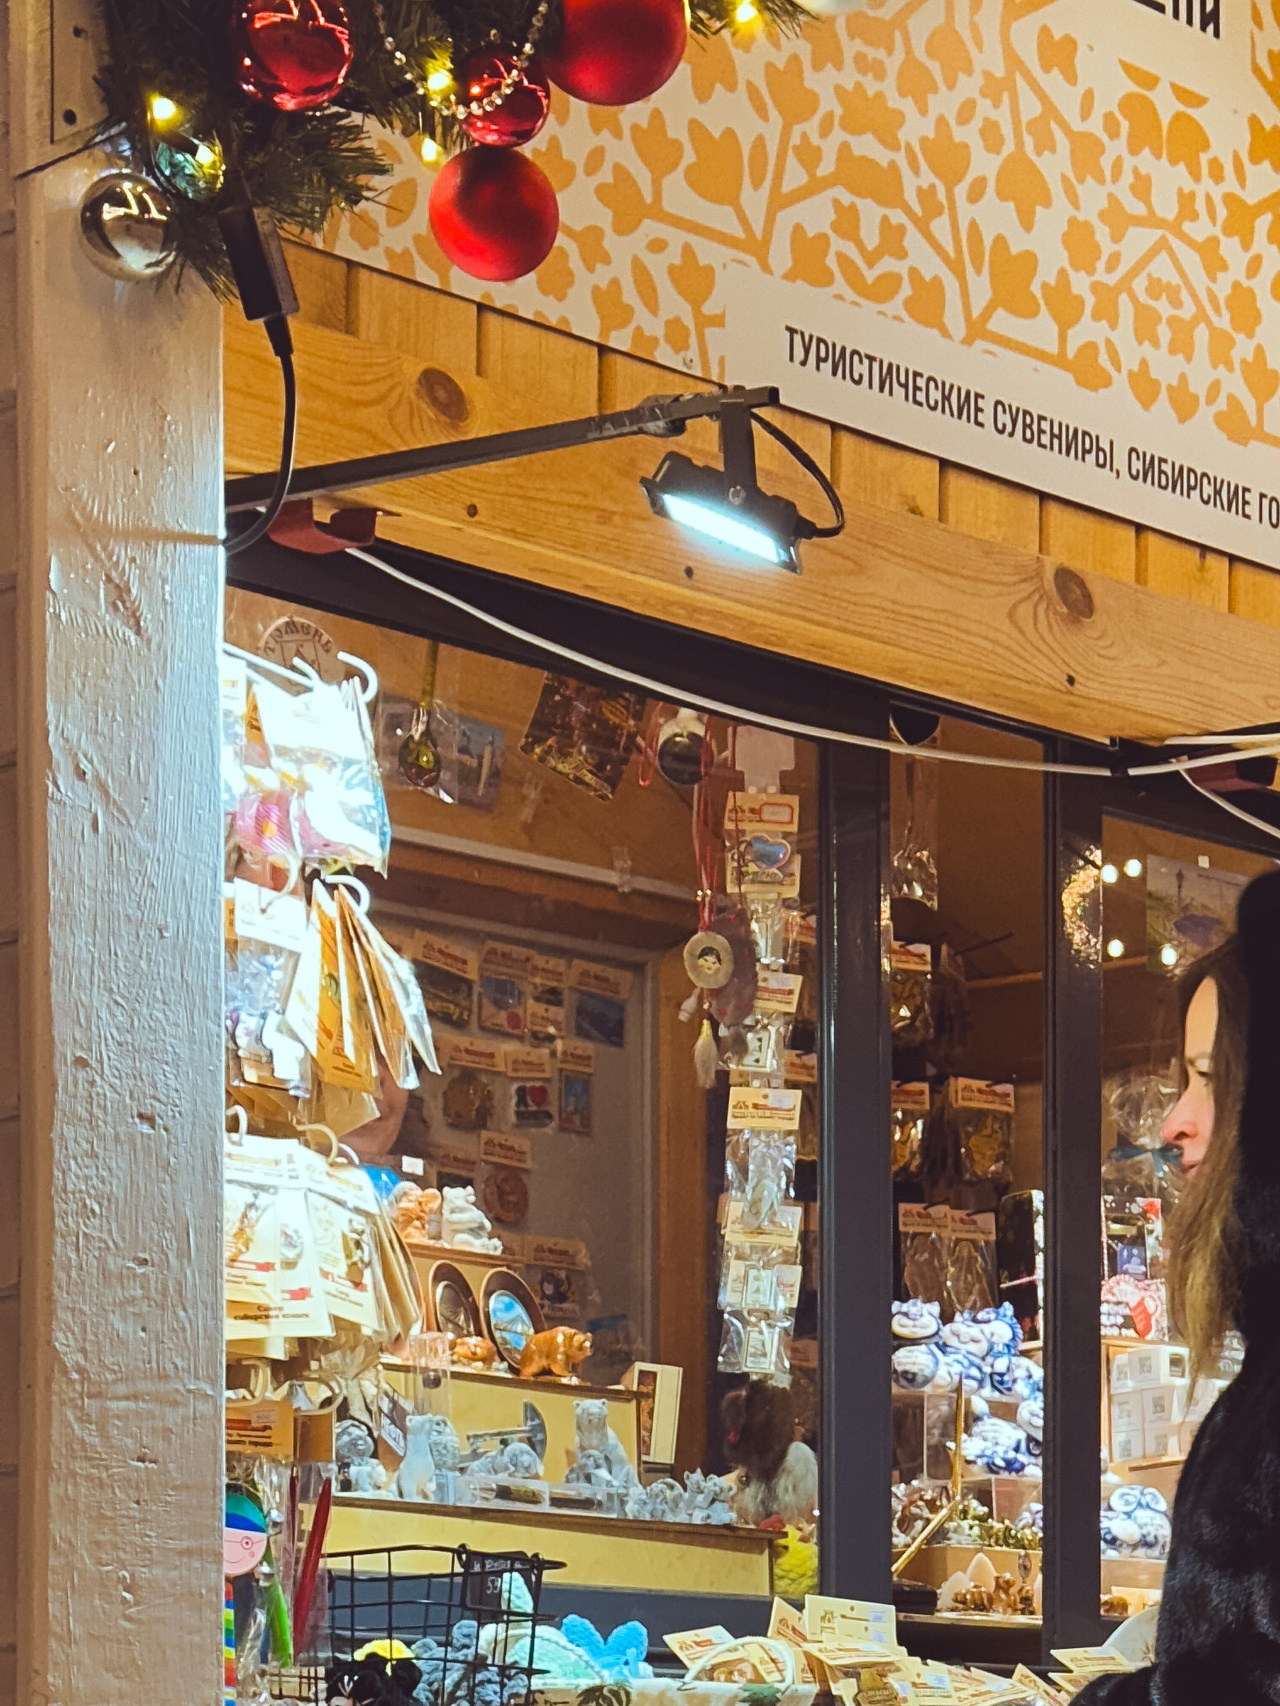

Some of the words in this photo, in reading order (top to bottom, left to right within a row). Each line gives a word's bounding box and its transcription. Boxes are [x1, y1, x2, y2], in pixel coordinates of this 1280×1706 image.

[785, 325, 985, 429] ТУРИСТИЧЕСКИЕ
[993, 399, 1120, 480] СУВЕНИРЫ,
[1127, 446, 1252, 520] СИБИРСКИЕ
